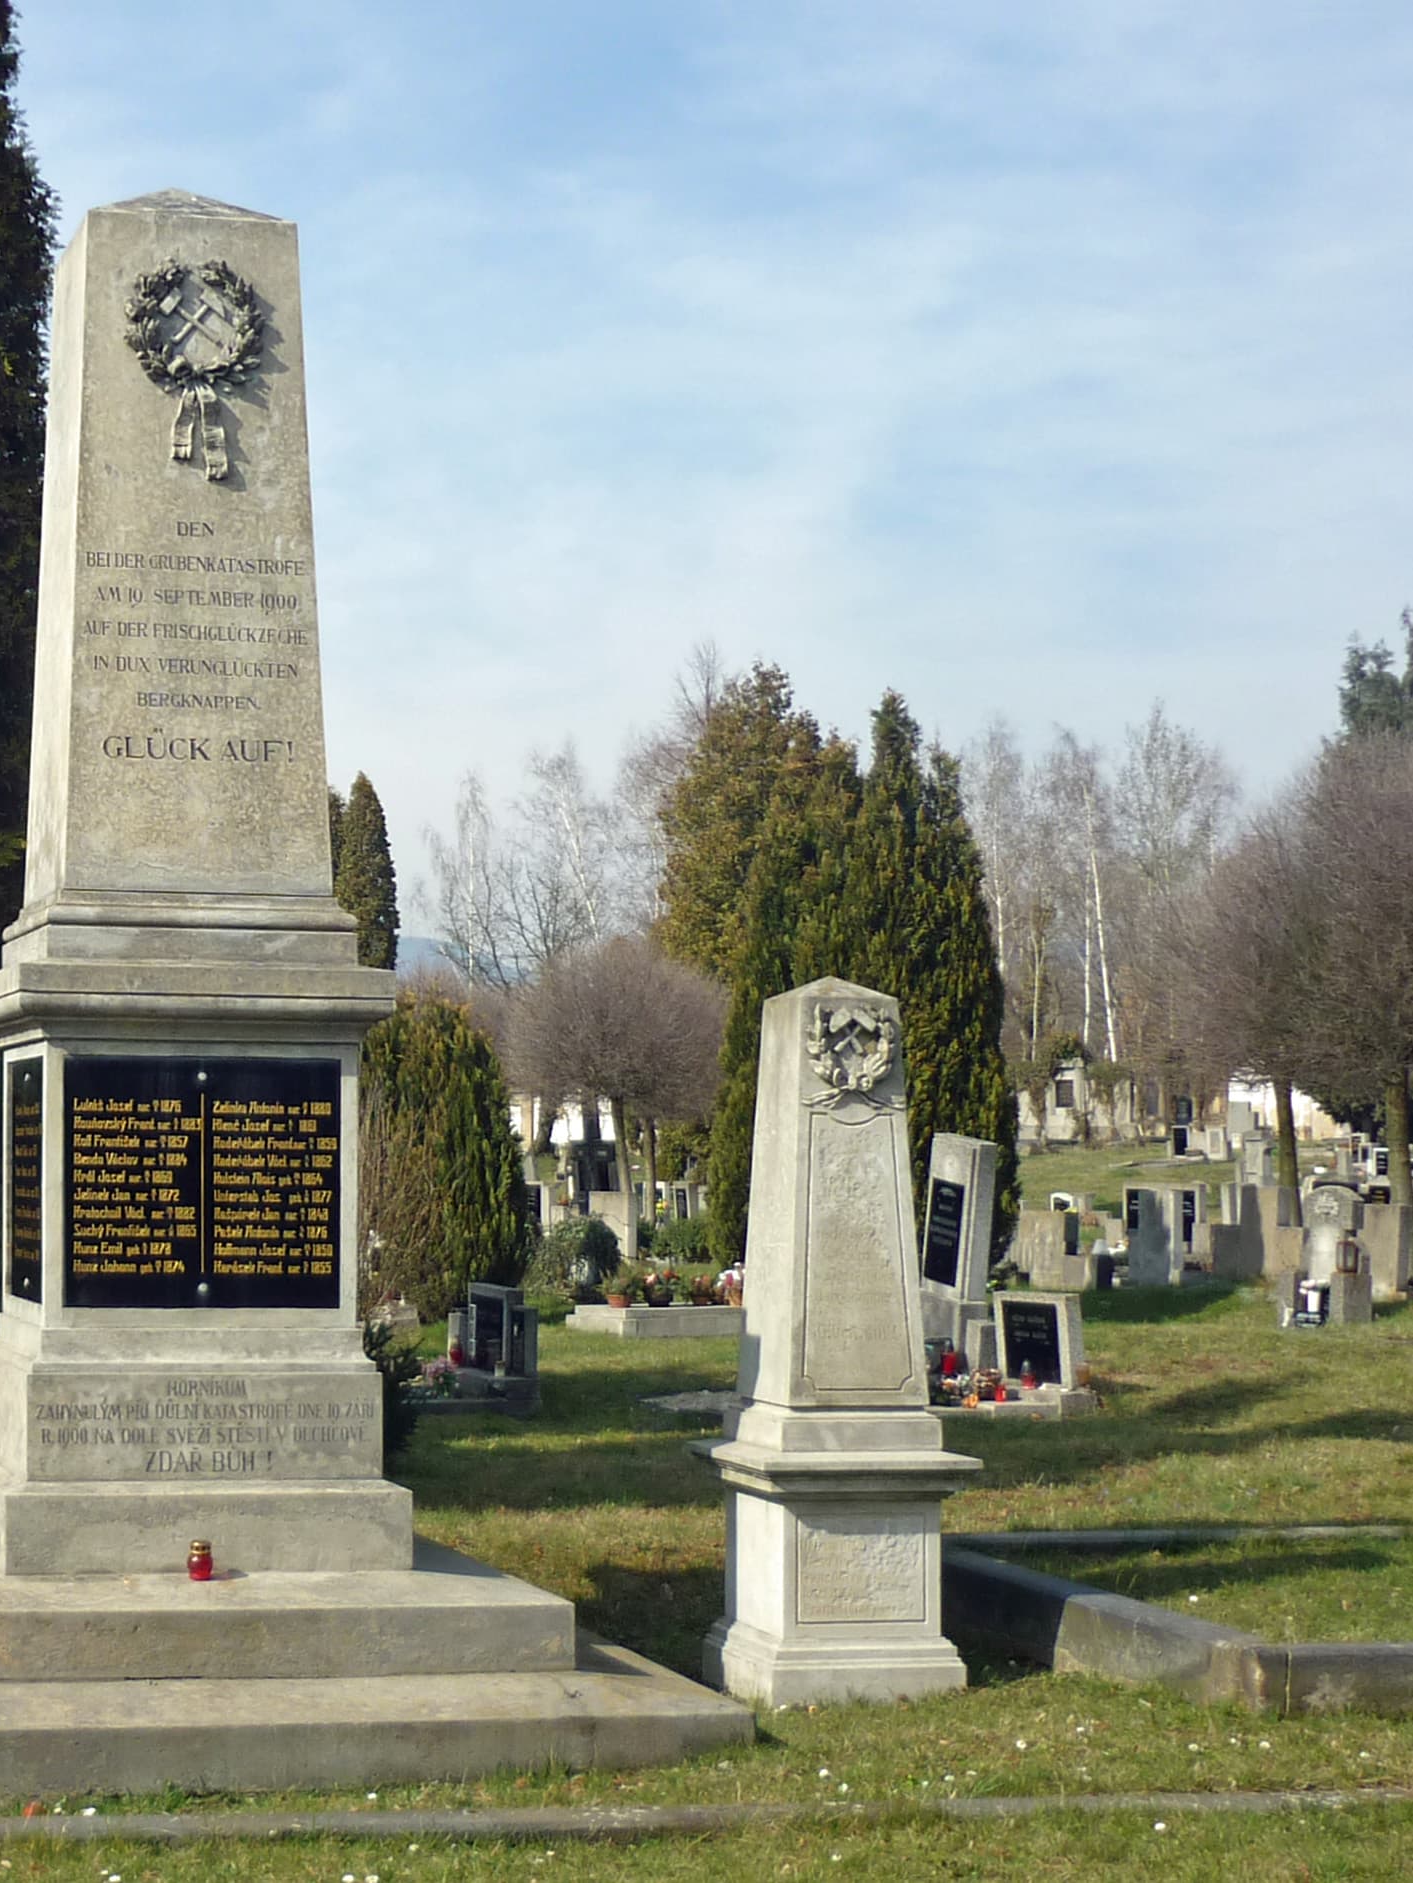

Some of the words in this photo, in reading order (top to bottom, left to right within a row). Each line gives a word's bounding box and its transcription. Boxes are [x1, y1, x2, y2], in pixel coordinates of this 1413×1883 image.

[176, 521, 215, 538] DEN
[86, 551, 111, 568] BEI
[114, 552, 145, 569] DER
[148, 554, 306, 576] GRUBENKATASTROFE
[95, 586, 121, 602] AM
[153, 588, 255, 608] SEPTEMBER
[84, 620, 113, 636] AUF
[117, 621, 148, 638] DER
[93, 655, 109, 670] IN
[116, 656, 150, 673] DUX
[102, 727, 211, 761] GLÜCK
[94, 1427, 114, 1444] NA
[274, 1425, 286, 1441] V
[145, 1447, 204, 1472] ZDAŘ
